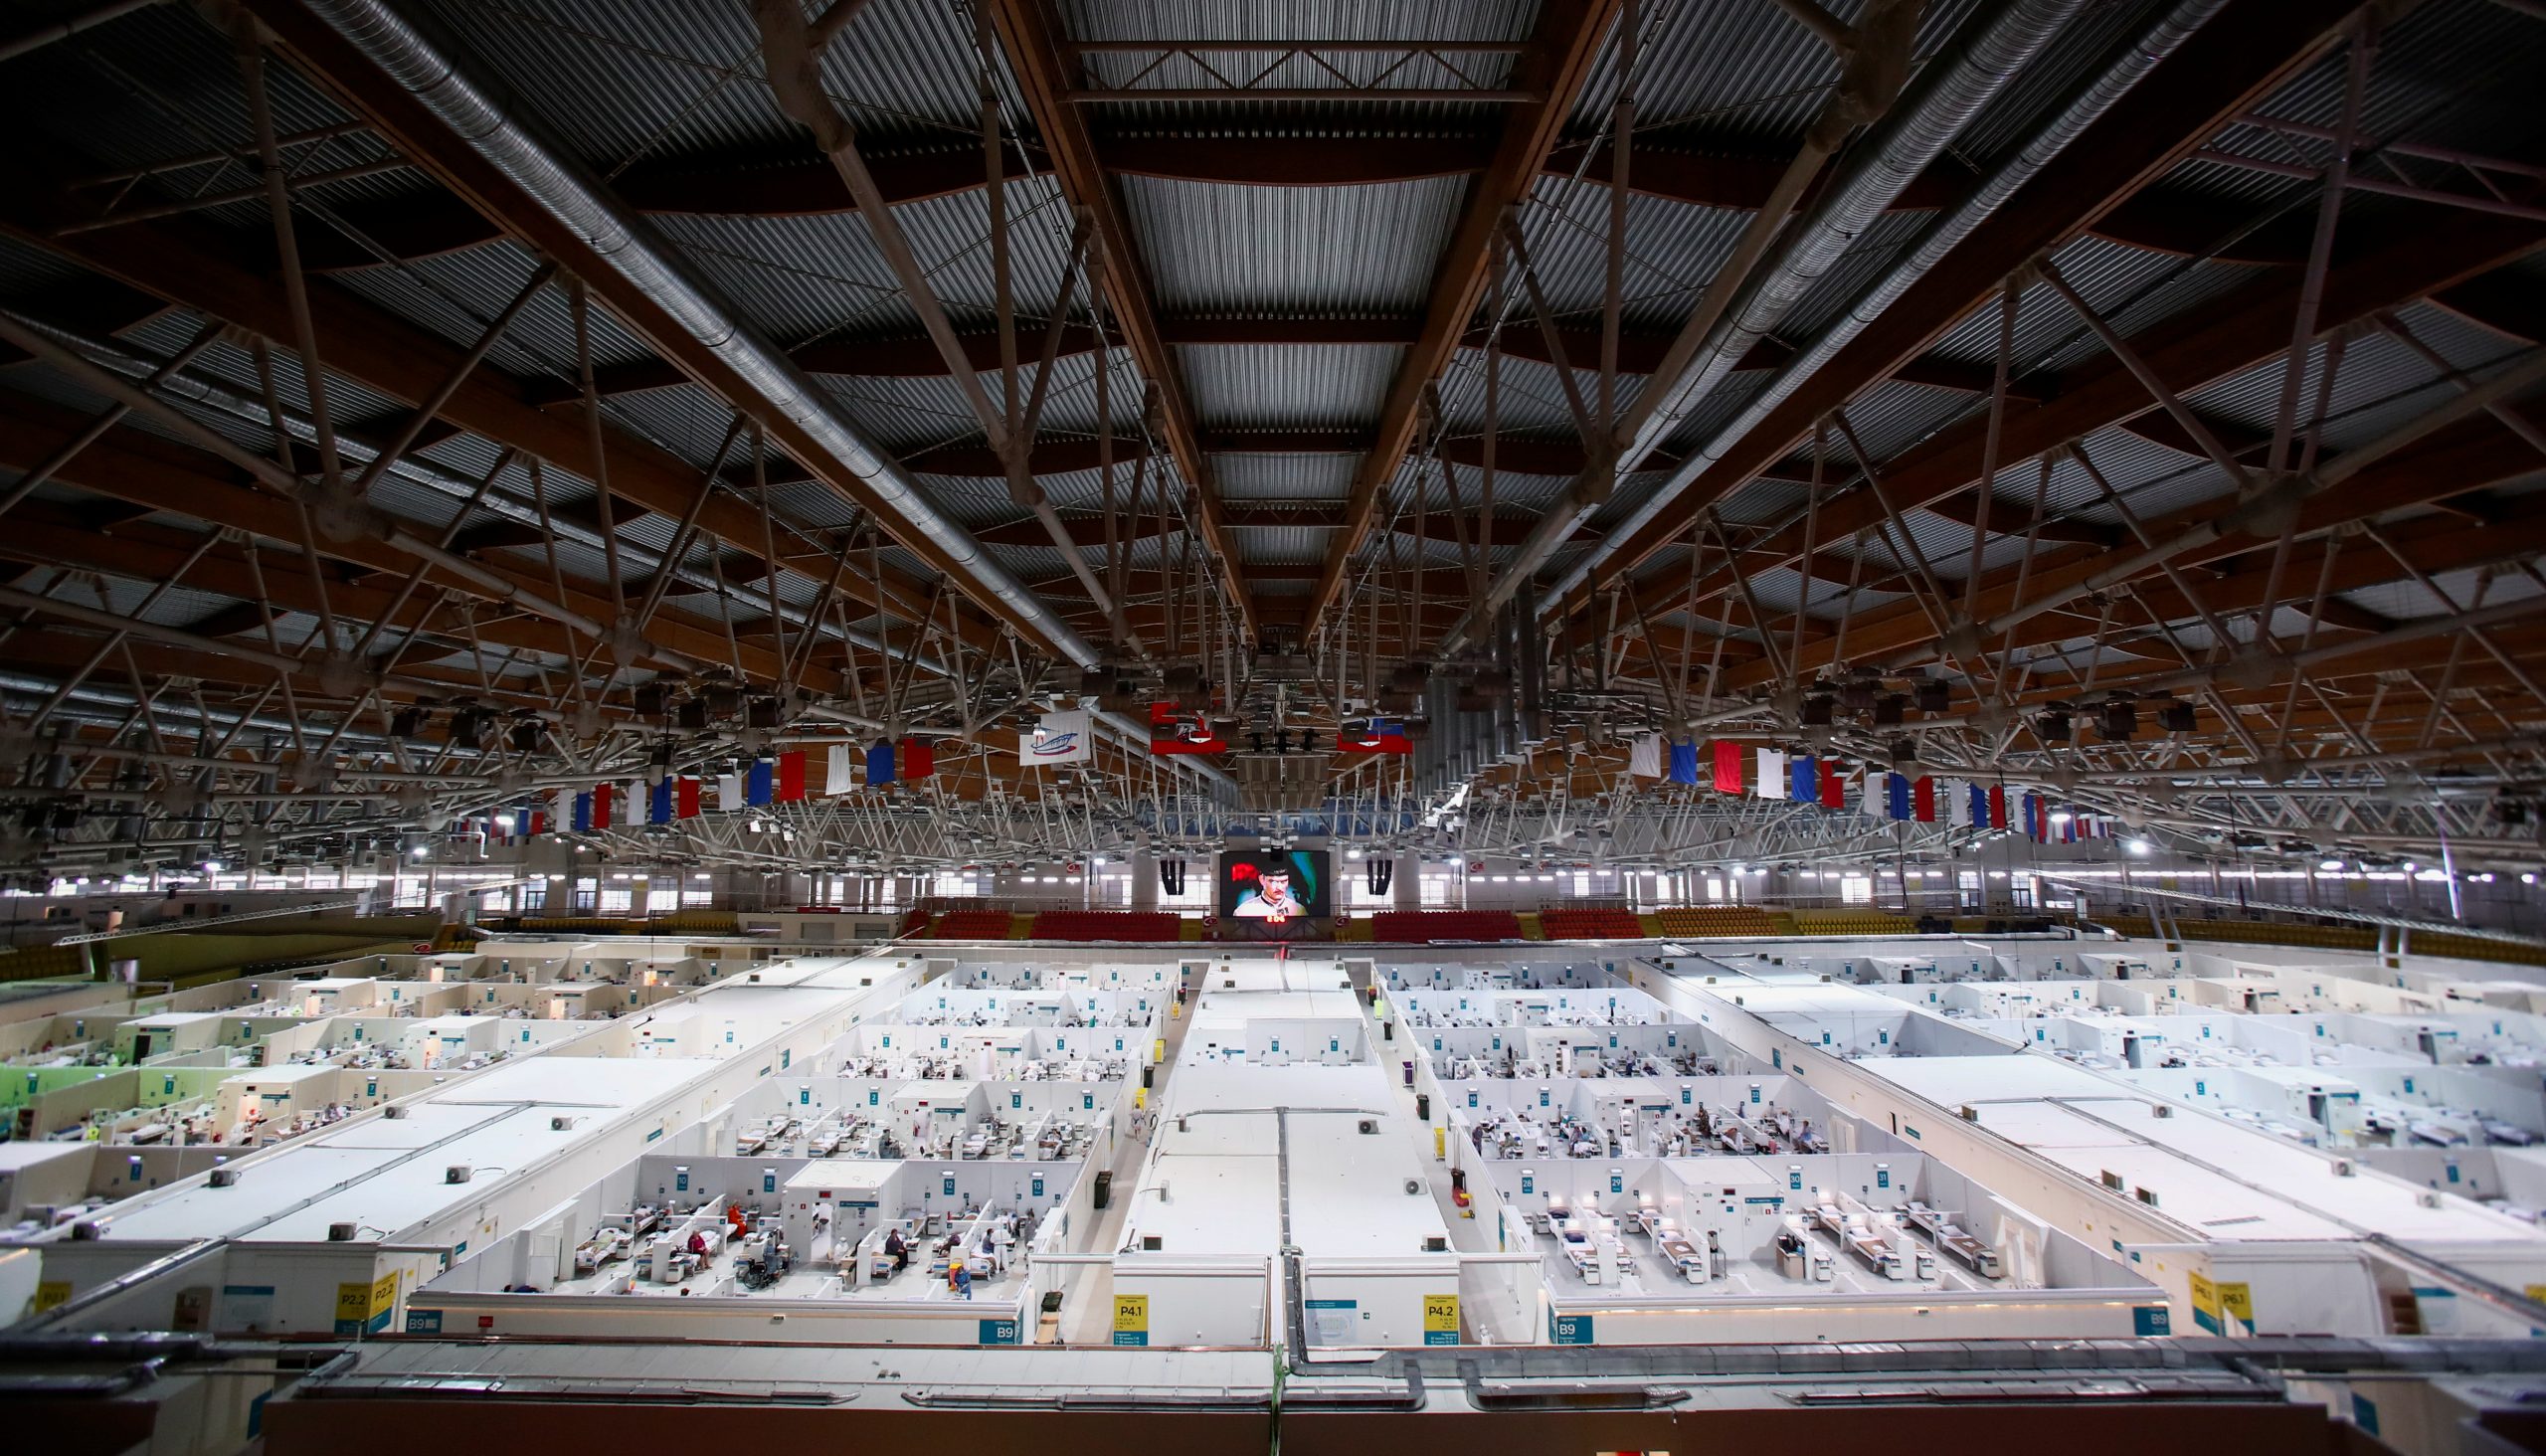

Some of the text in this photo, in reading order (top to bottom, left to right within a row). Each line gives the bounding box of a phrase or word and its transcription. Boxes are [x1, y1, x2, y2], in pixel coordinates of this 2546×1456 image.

[1790, 1175, 1800, 1183] 30
[375, 1283, 394, 1301] P2.2
[342, 1295, 366, 1305] P2.2
[2223, 1294, 2245, 1305] P6.1
[1121, 1306, 1142, 1317] P4.1
[1429, 1306, 1453, 1317] P4.2
[408, 1318, 424, 1330] B9
[2150, 1314, 2167, 1325] B9
[997, 1327, 1013, 1339] B9
[1559, 1324, 1575, 1335] B9
